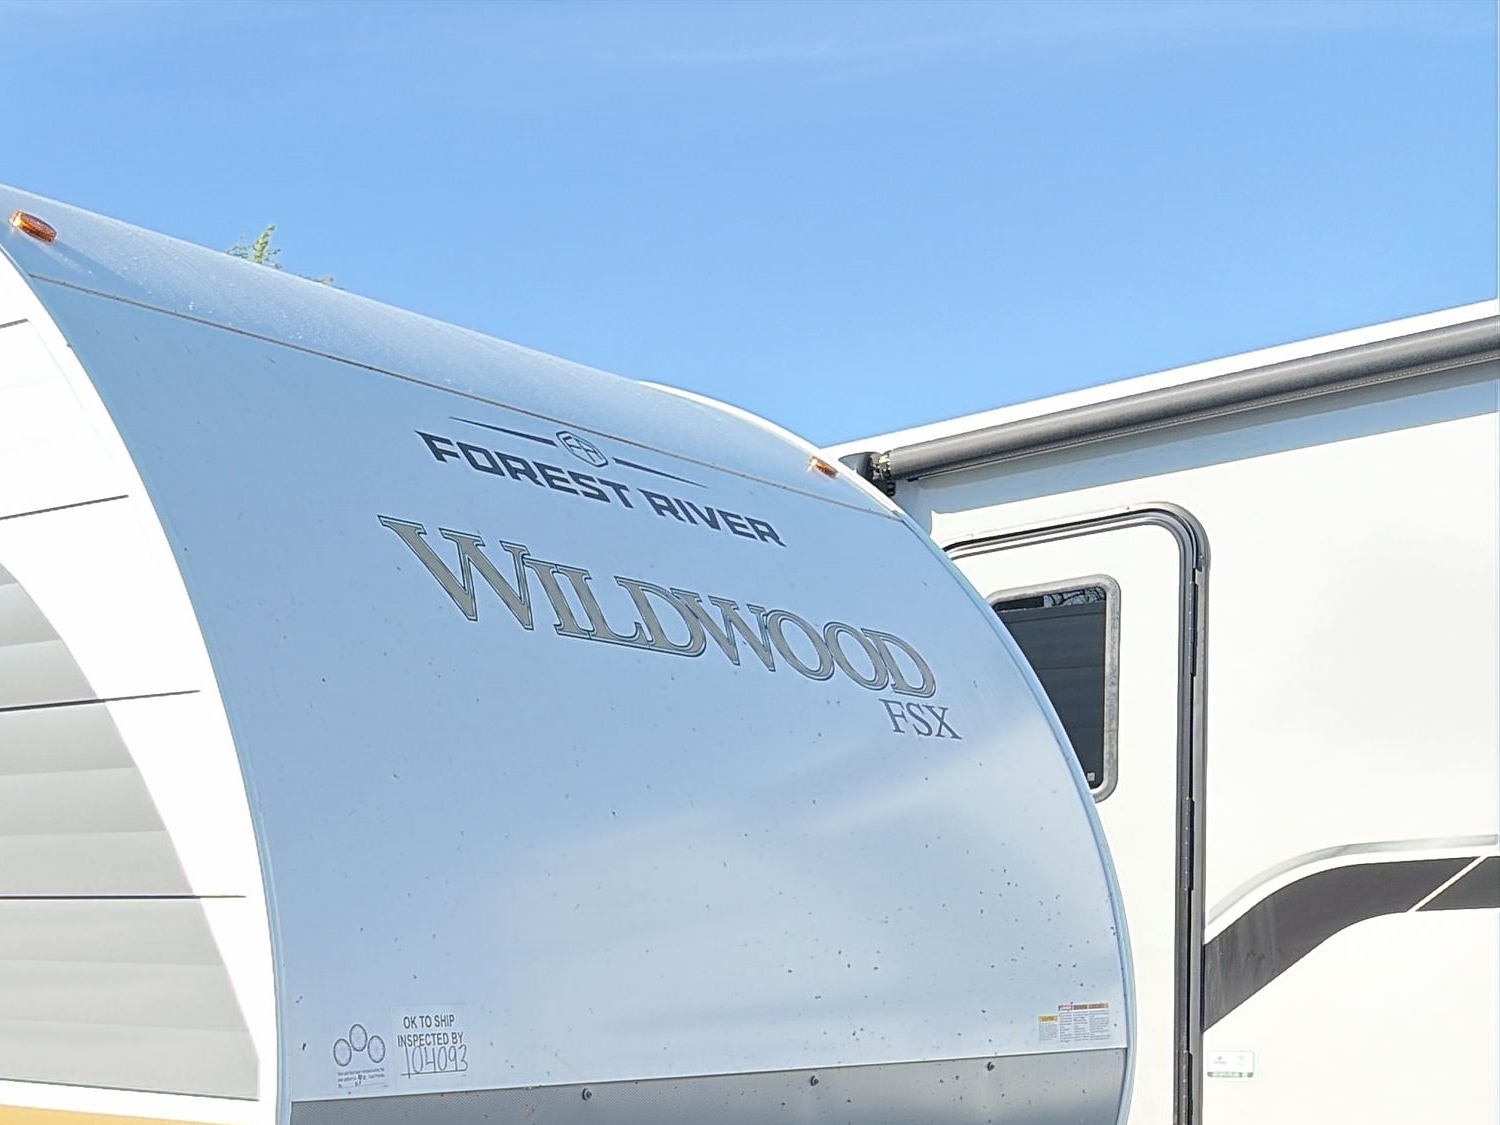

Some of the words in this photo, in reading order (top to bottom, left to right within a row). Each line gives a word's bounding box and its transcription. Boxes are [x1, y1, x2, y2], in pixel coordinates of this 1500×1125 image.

[416, 431, 632, 509] FOREST
[638, 489, 787, 547] RIVER
[378, 516, 937, 699] WILDWOOD
[879, 699, 962, 740] FSX
[397, 1032, 449, 1048] INSPECTED
[451, 1032, 464, 1045] BY
[403, 1016, 418, 1030] OK
[419, 1015, 432, 1029] TO
[434, 1014, 455, 1028] SHIP
